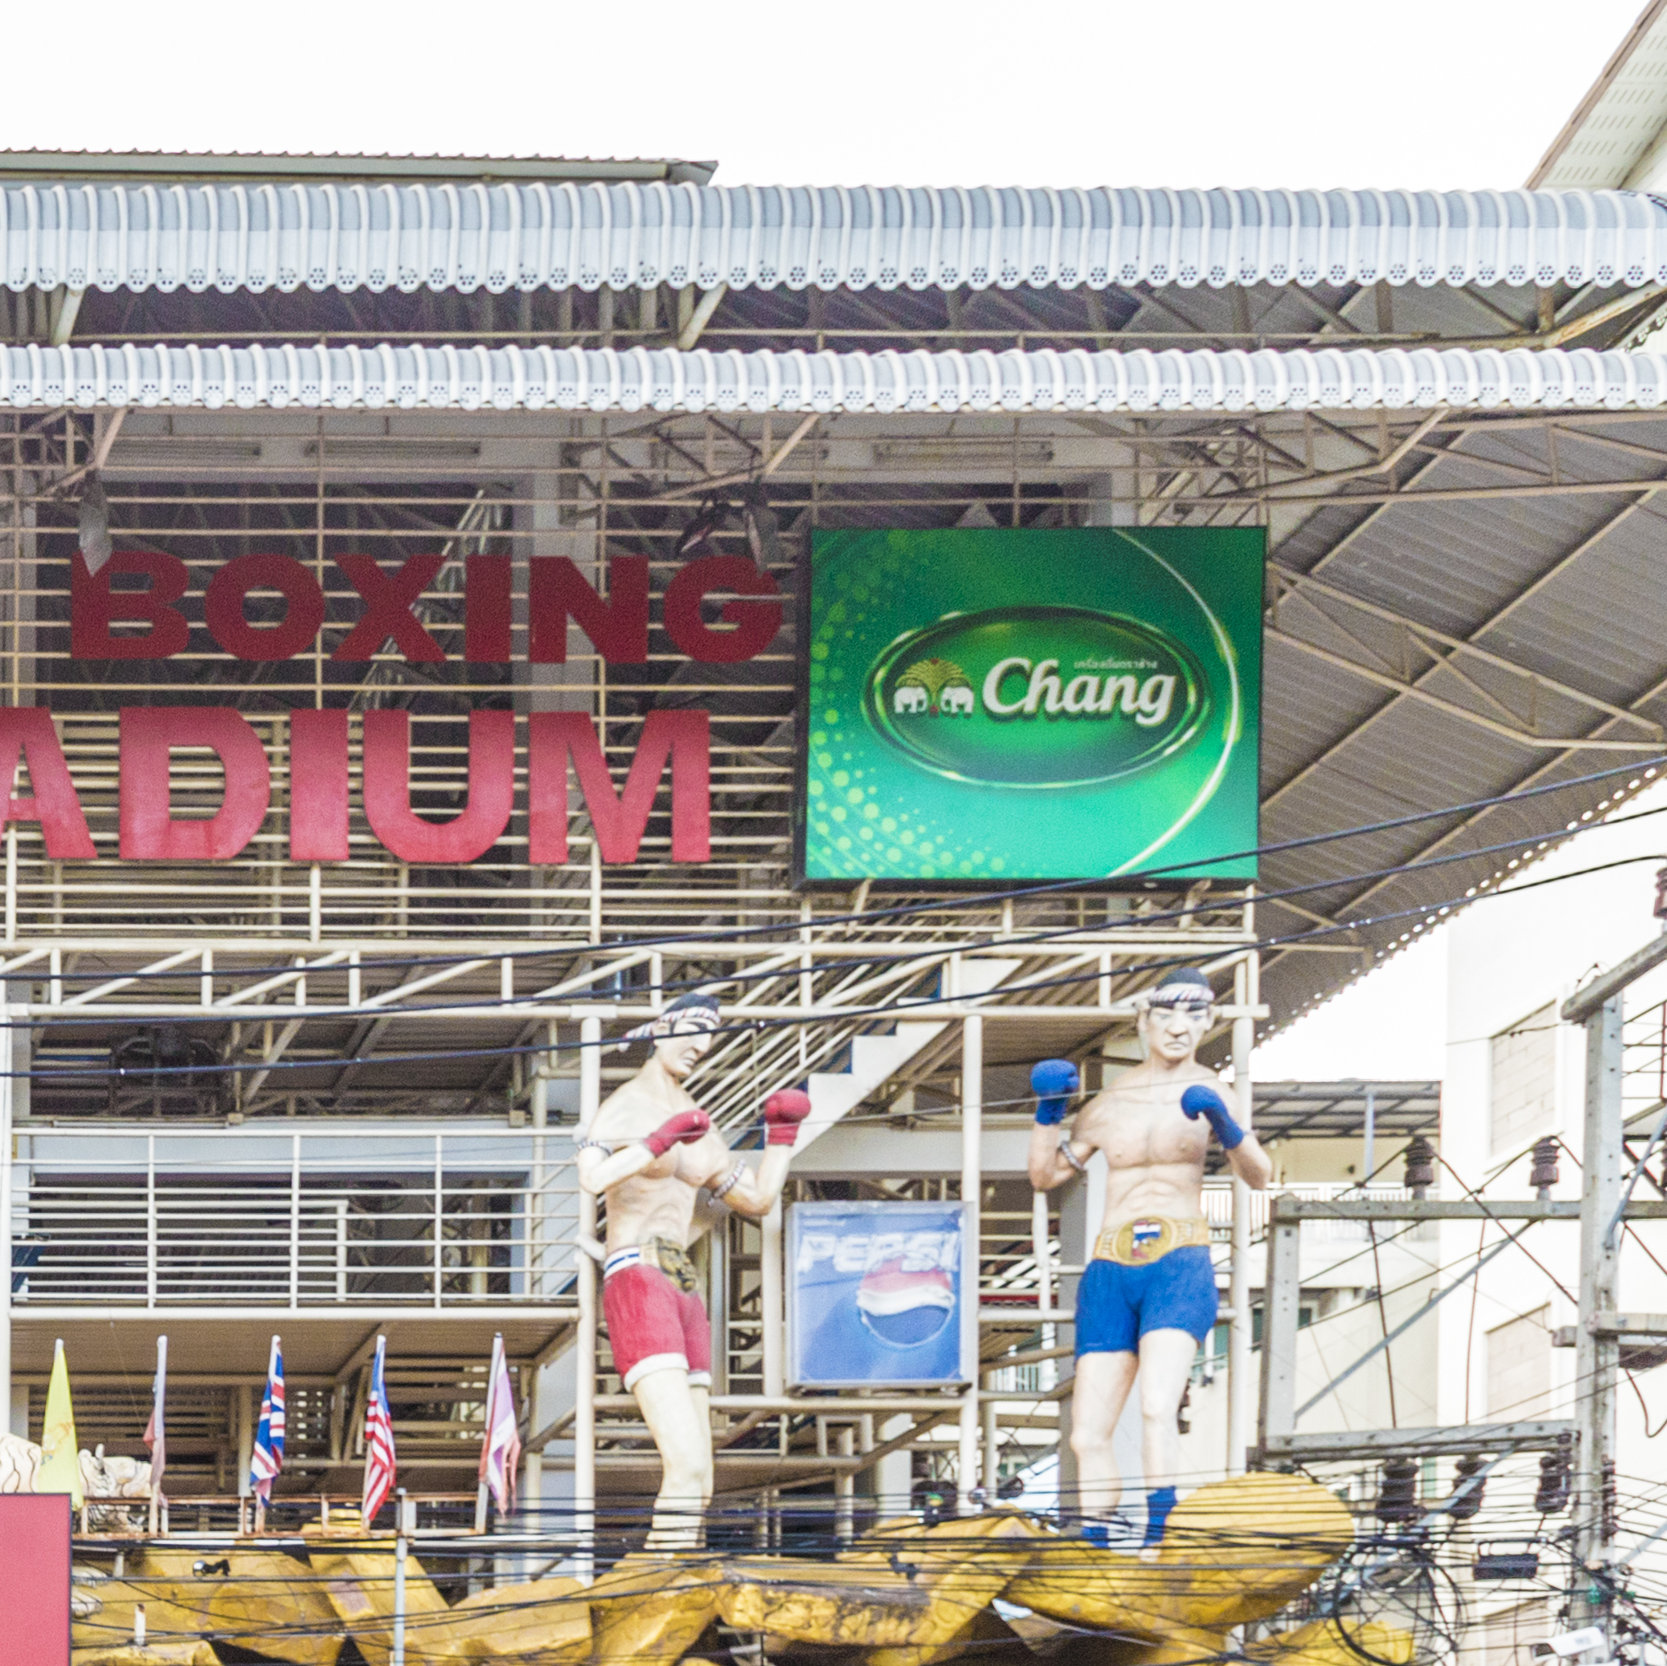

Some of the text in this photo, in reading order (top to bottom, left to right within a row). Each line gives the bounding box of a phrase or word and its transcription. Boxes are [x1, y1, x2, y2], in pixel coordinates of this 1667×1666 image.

[70, 550, 784, 664] BOXING
[982, 656, 1177, 726] Chang
[797, 1232, 959, 1273] PEPSI
